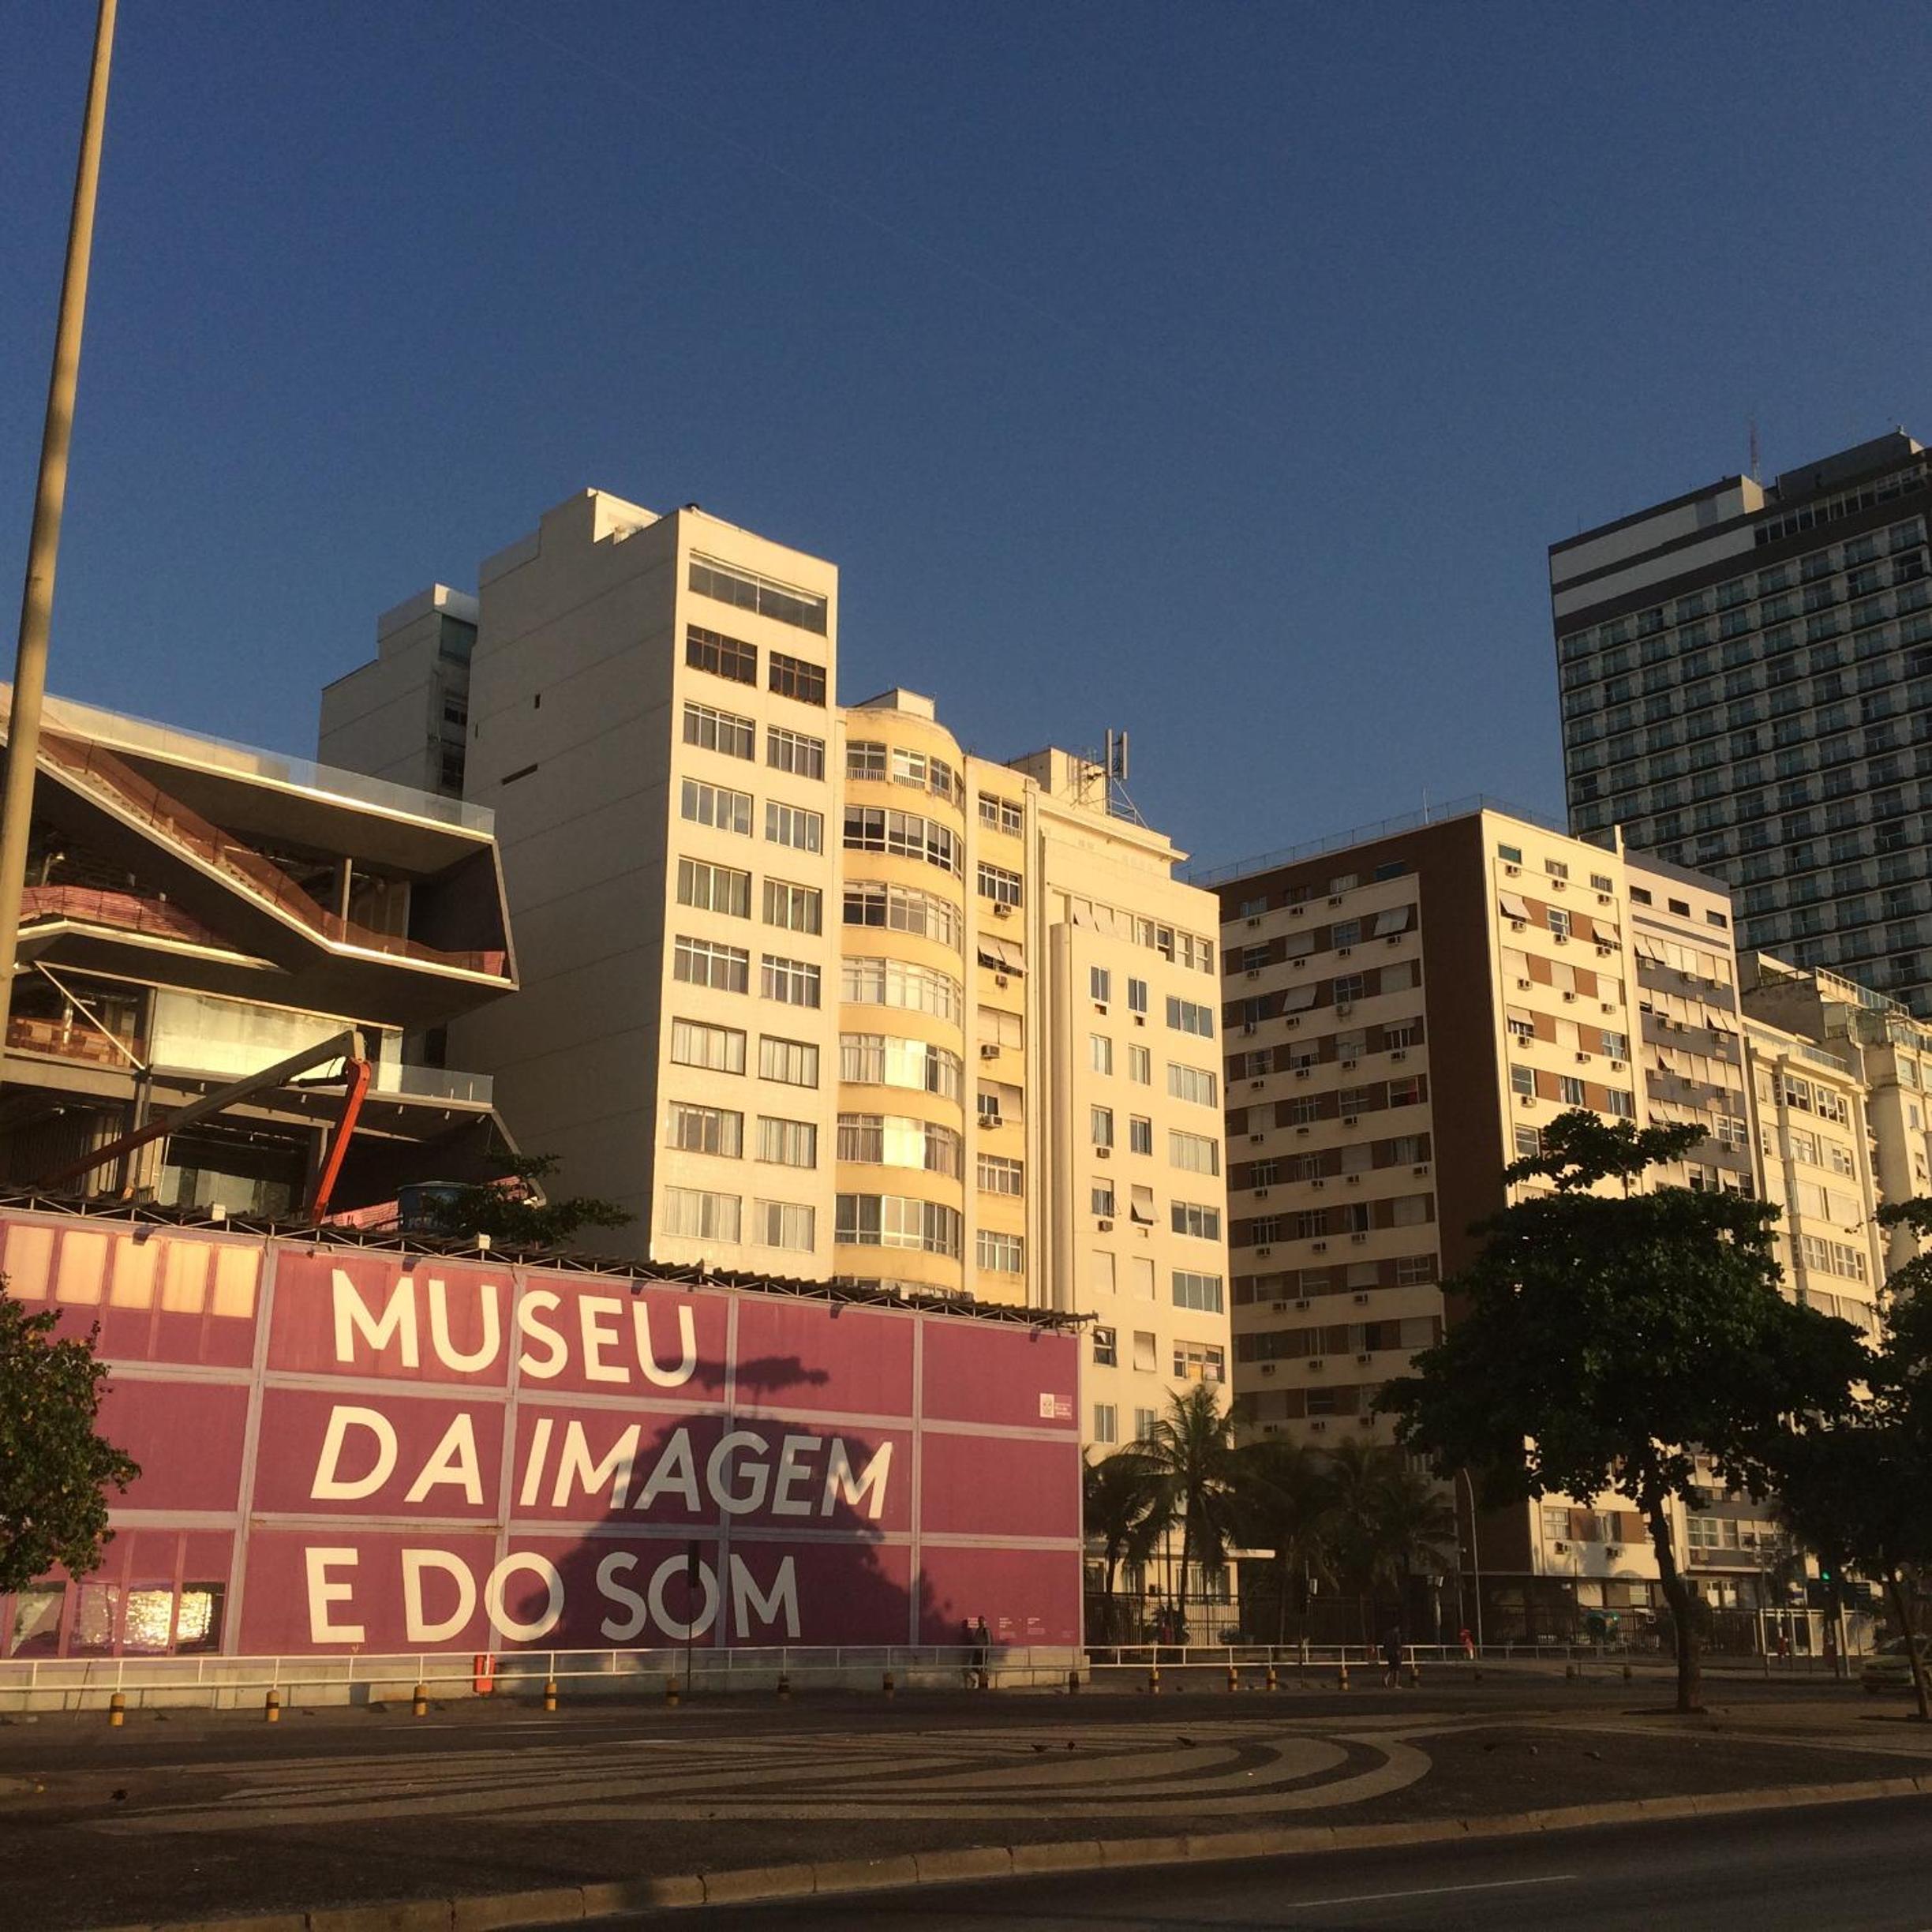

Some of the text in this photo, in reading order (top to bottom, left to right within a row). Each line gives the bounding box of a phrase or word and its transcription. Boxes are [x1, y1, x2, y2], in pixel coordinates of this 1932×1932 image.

[332, 1269, 697, 1387] MUSEU
[310, 1406, 893, 1518] DA IMAGEM
[305, 1548, 800, 1643] E DO SOM
